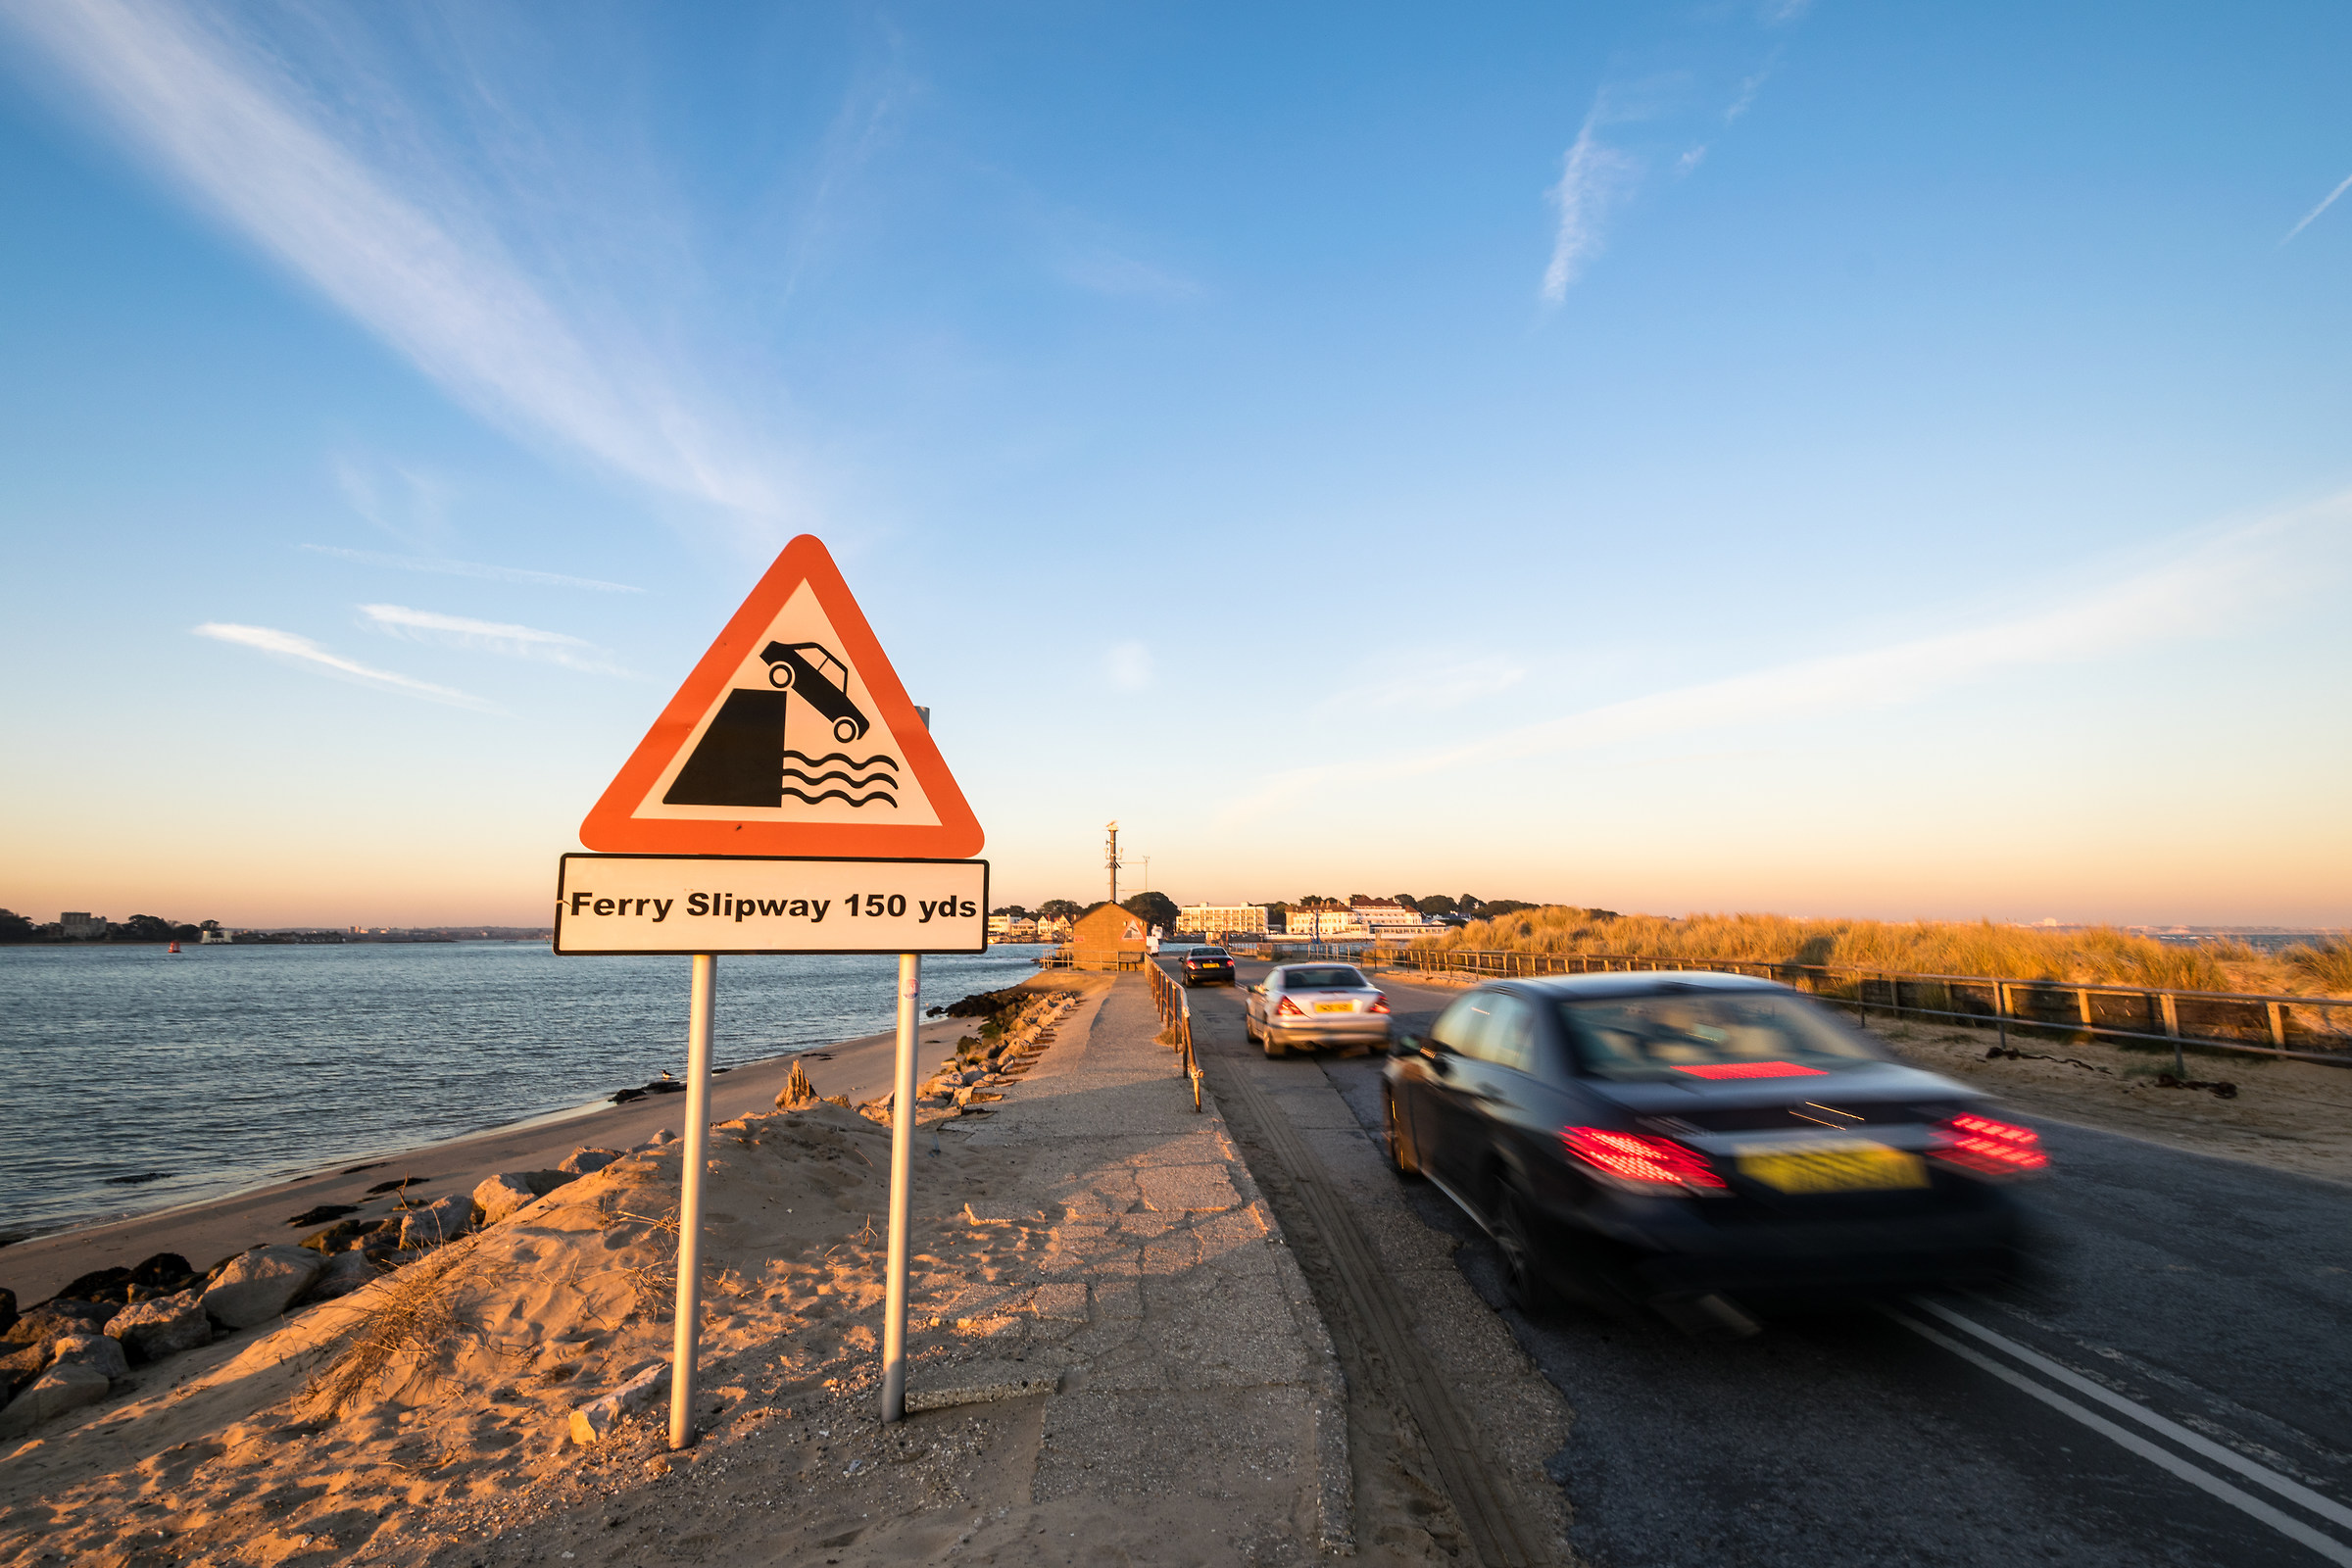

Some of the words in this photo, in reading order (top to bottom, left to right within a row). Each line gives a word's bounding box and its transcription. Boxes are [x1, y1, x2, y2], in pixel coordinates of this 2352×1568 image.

[570, 892, 674, 923] Ferry
[686, 892, 831, 923] Slipway
[844, 893, 906, 917] 150
[918, 895, 977, 922] yds
